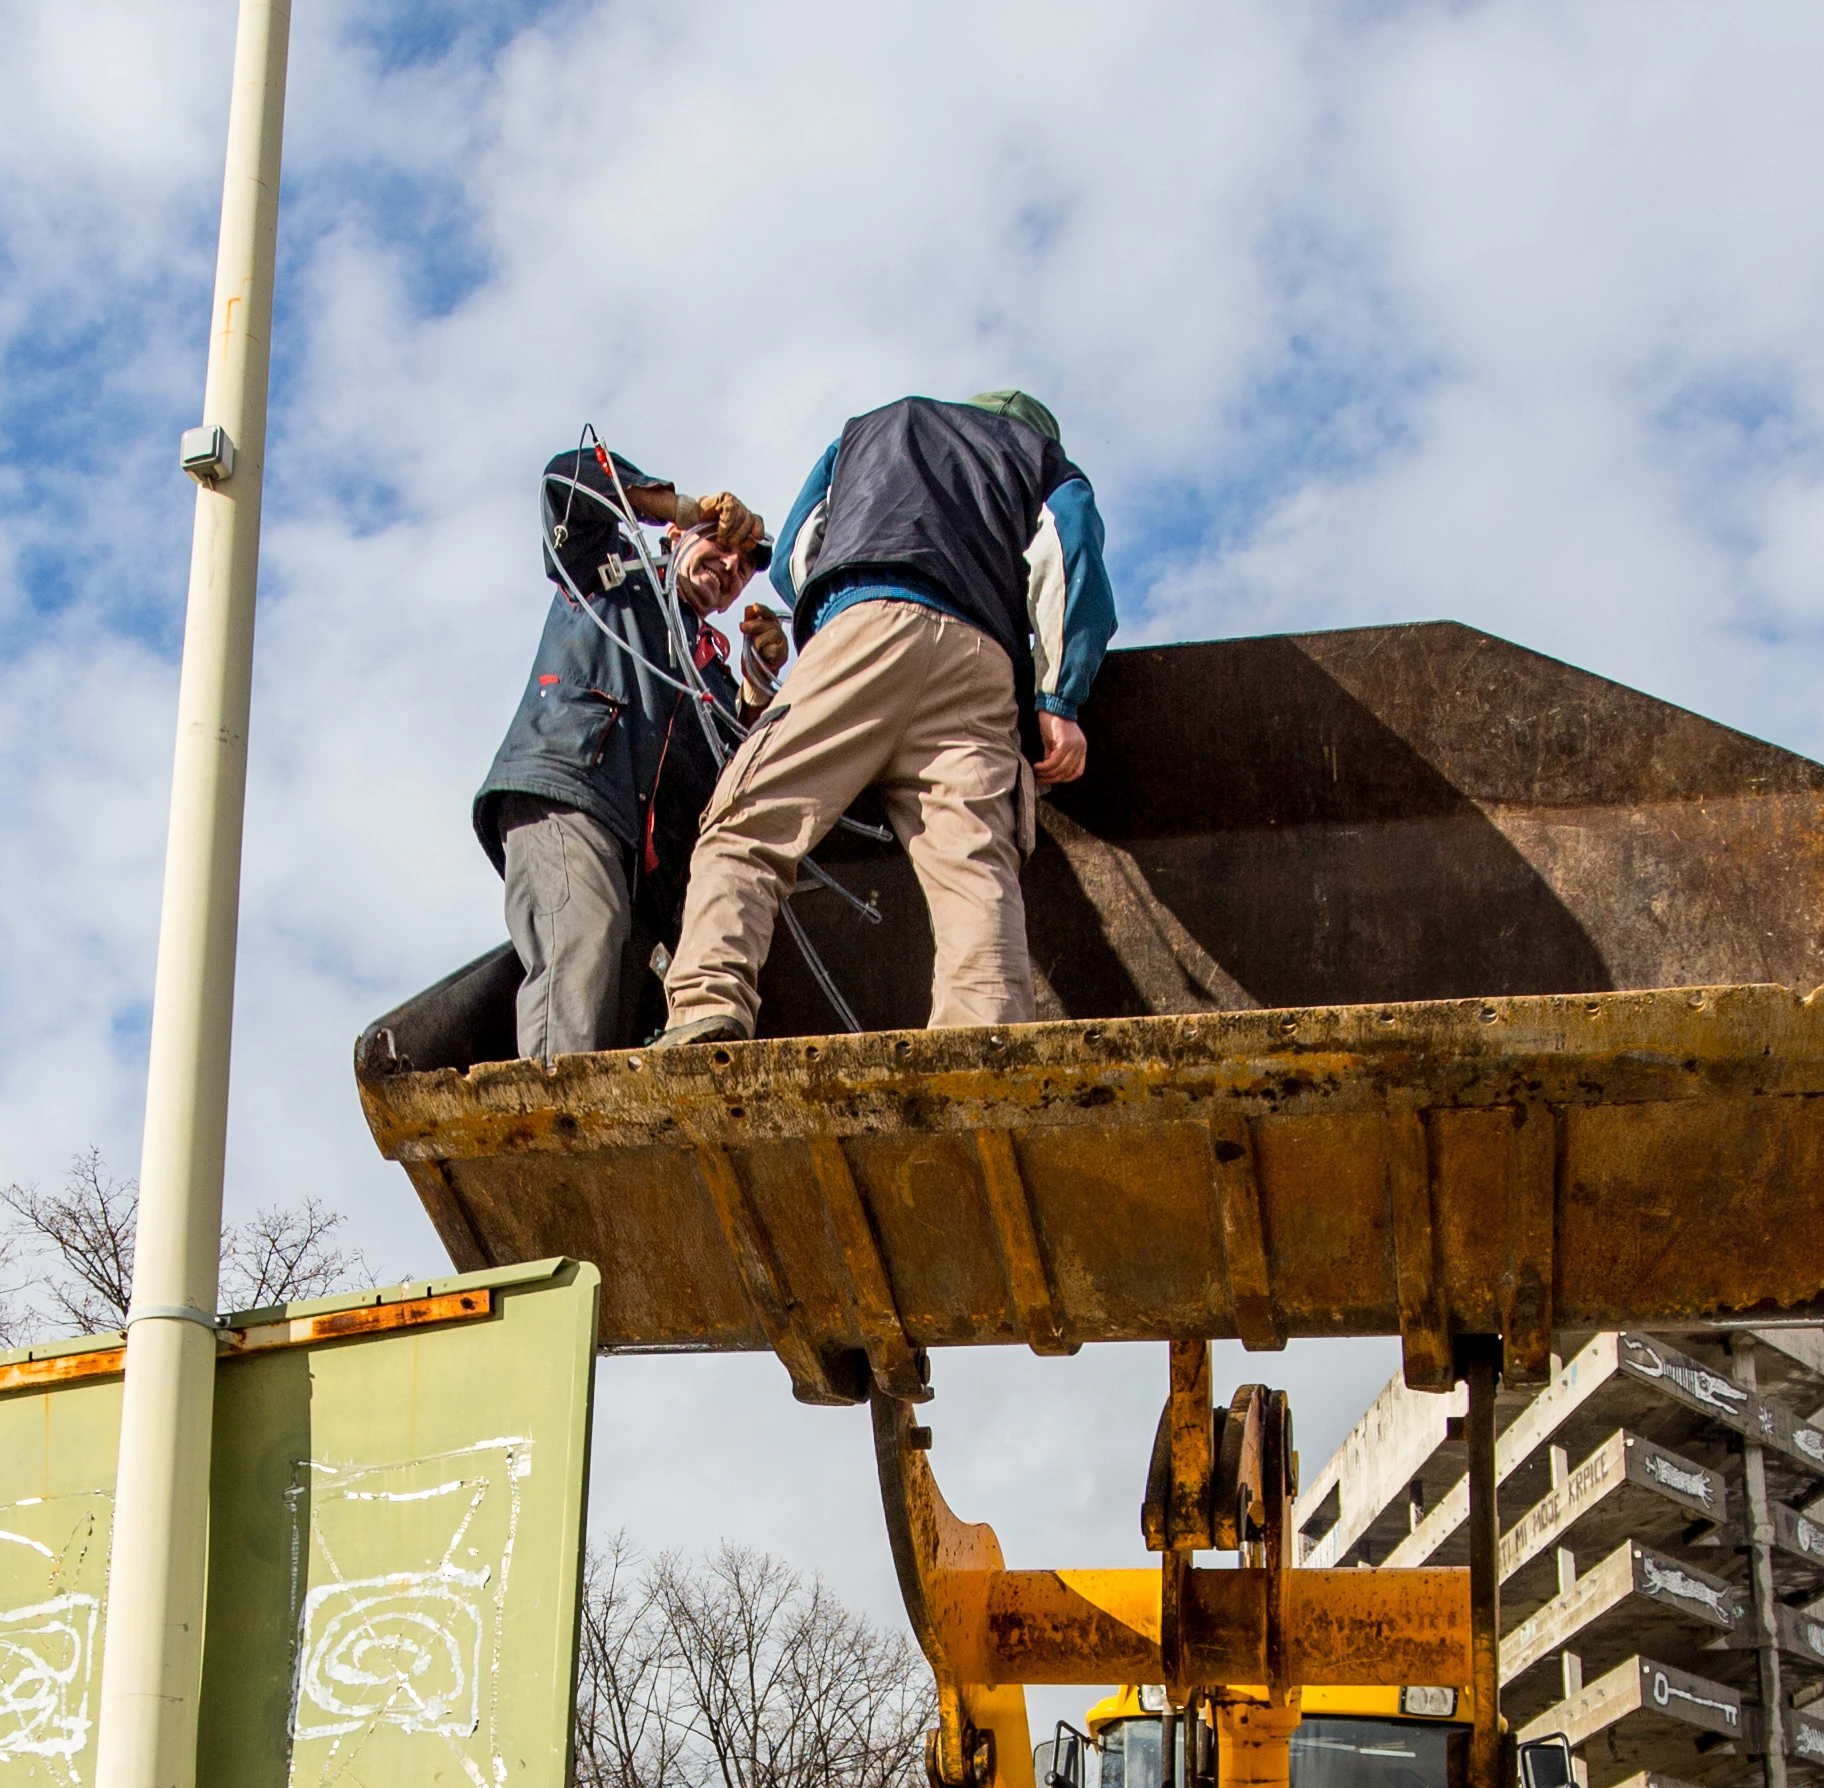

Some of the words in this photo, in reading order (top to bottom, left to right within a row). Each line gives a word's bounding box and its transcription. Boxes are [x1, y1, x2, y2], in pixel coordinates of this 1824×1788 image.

[1515, 1523, 1528, 1553] MI
[1532, 1493, 1561, 1537] MOJE
[1567, 1451, 1609, 1507] KRPICE
